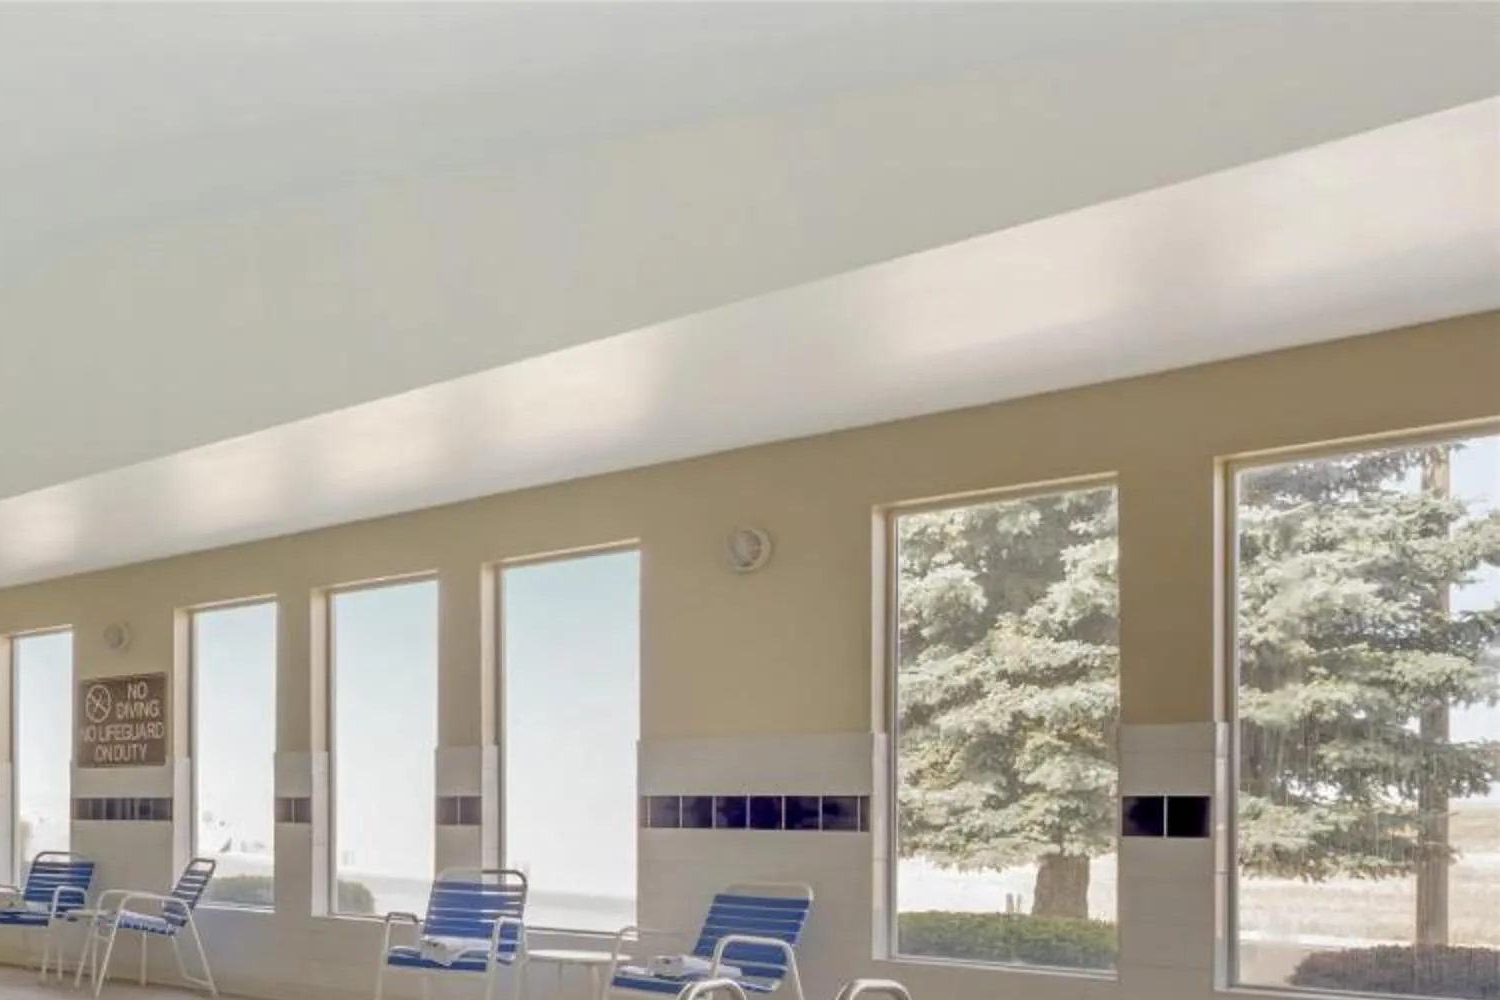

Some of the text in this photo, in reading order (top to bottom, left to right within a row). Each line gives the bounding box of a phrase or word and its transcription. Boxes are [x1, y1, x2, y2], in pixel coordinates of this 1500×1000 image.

[127, 681, 148, 700] NO
[116, 700, 160, 719] DIVING
[98, 721, 165, 741] LIFEGUARD
[114, 743, 147, 762] DUTY
